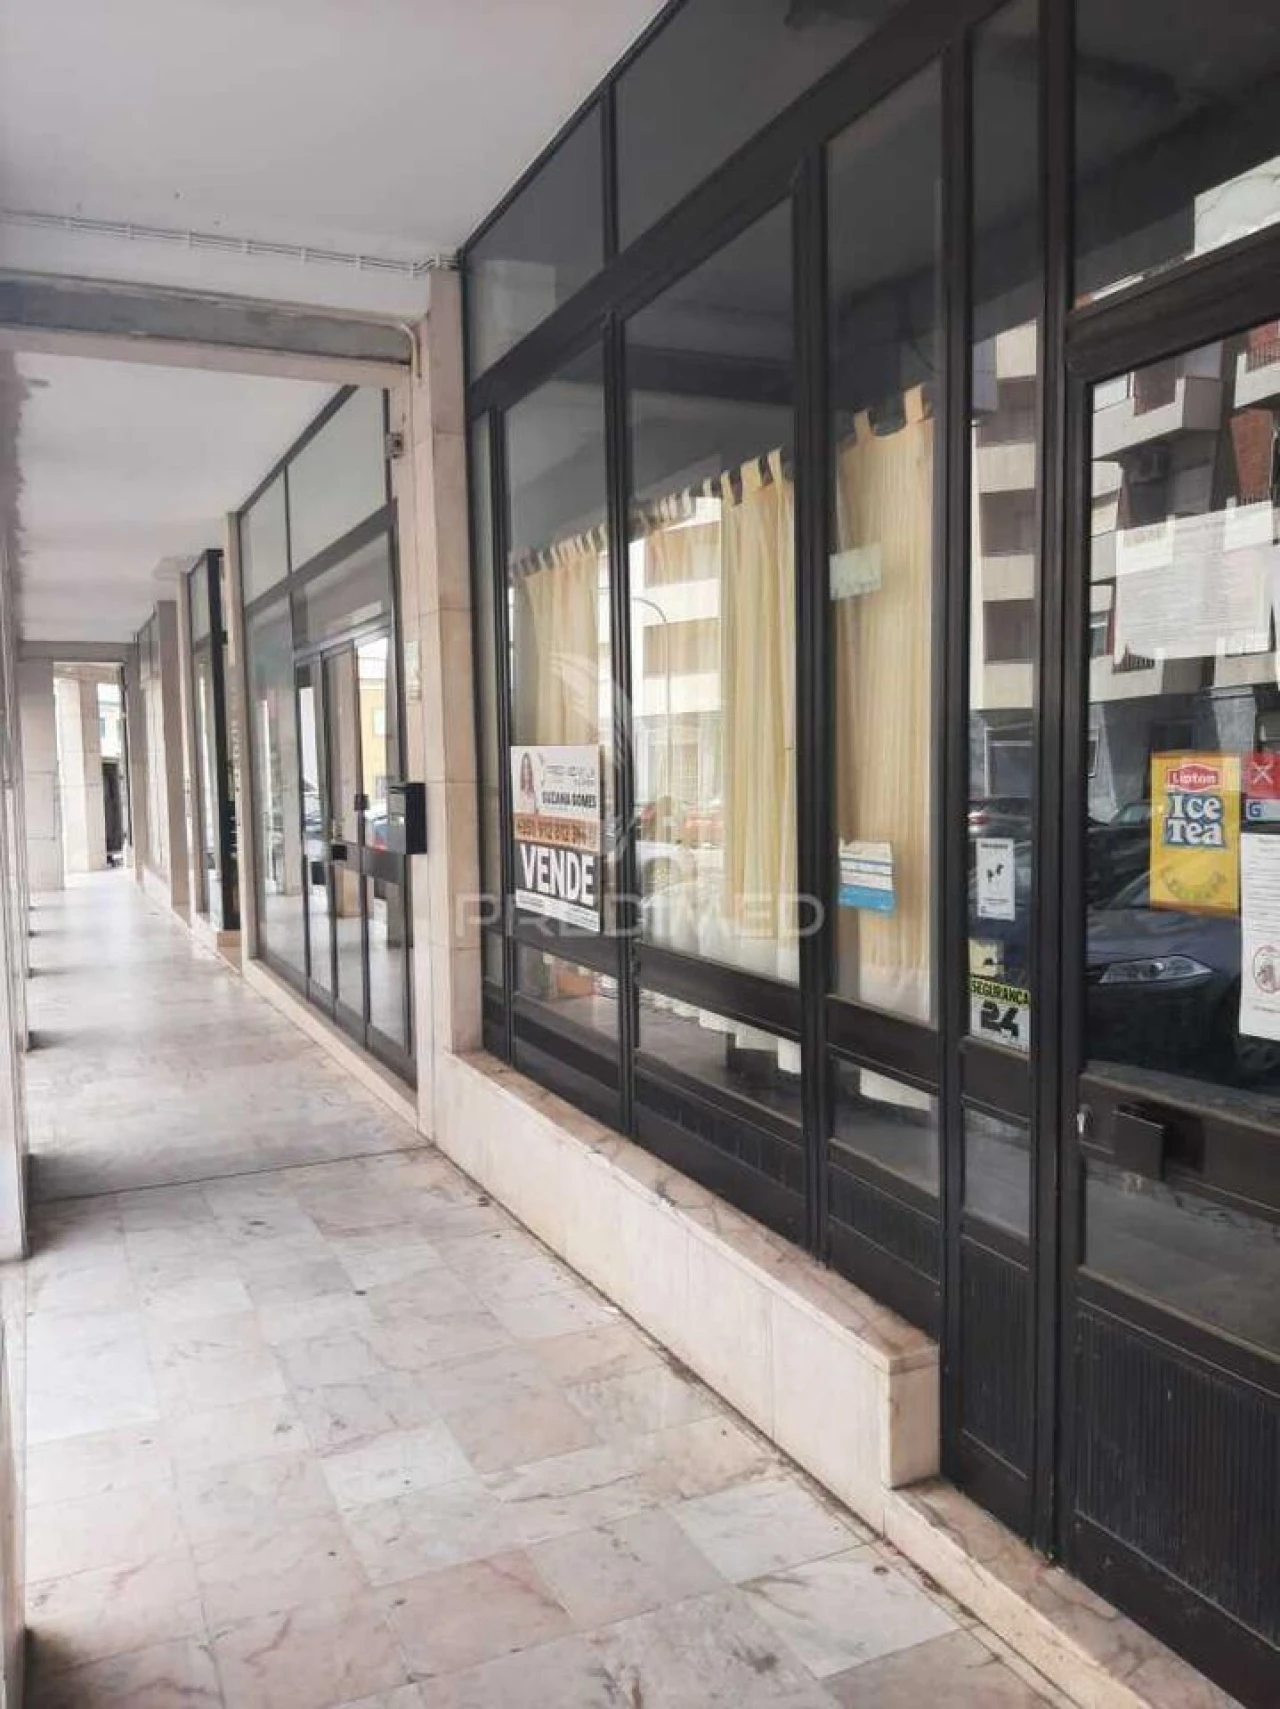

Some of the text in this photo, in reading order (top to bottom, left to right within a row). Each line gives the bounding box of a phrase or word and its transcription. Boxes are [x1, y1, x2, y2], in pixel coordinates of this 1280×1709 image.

[1172, 772, 1217, 786] Lipton
[1170, 795, 1222, 820] Ice
[1167, 819, 1222, 845] Tea
[520, 844, 594, 907] VENDE
[981, 999, 1019, 1037] 24
